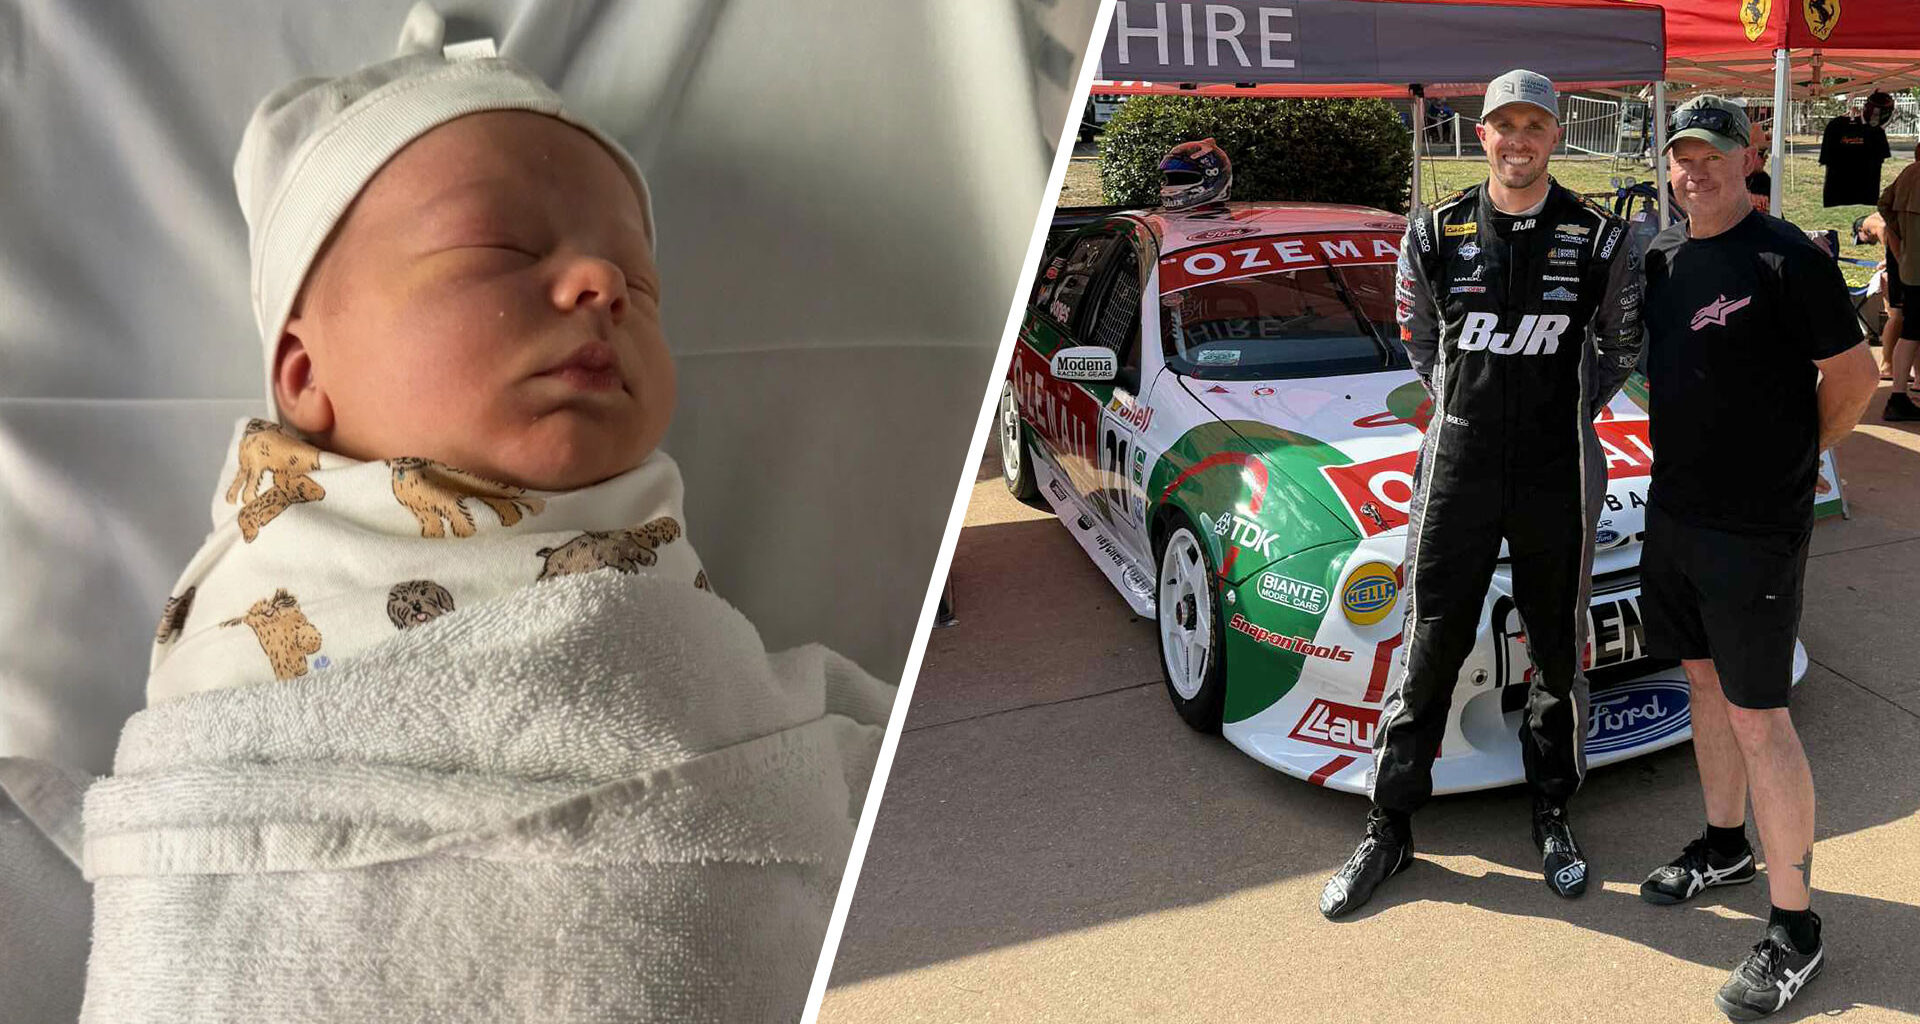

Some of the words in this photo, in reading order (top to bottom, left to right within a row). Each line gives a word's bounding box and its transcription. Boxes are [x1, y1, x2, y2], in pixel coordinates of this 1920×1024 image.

[1117, 2, 1296, 69] HIRE
[1512, 218, 1537, 232] BJR
[1183, 239, 1401, 276] OZEMA
[1600, 226, 1621, 259] sparco
[1457, 311, 1571, 356] BJR
[1057, 357, 1112, 371] Modena
[1088, 371, 1113, 379] GEARS
[1106, 429, 1129, 514] 21
[1230, 516, 1280, 558] TDK
[1261, 588, 1290, 604] MODEL
[1293, 597, 1320, 612] CARS
[1263, 574, 1325, 604] BIANTE
[1347, 579, 1397, 604] HELLA
[1292, 636, 1354, 662] Tools
[1297, 703, 1374, 748] Lau
[1587, 694, 1668, 739] Ford
